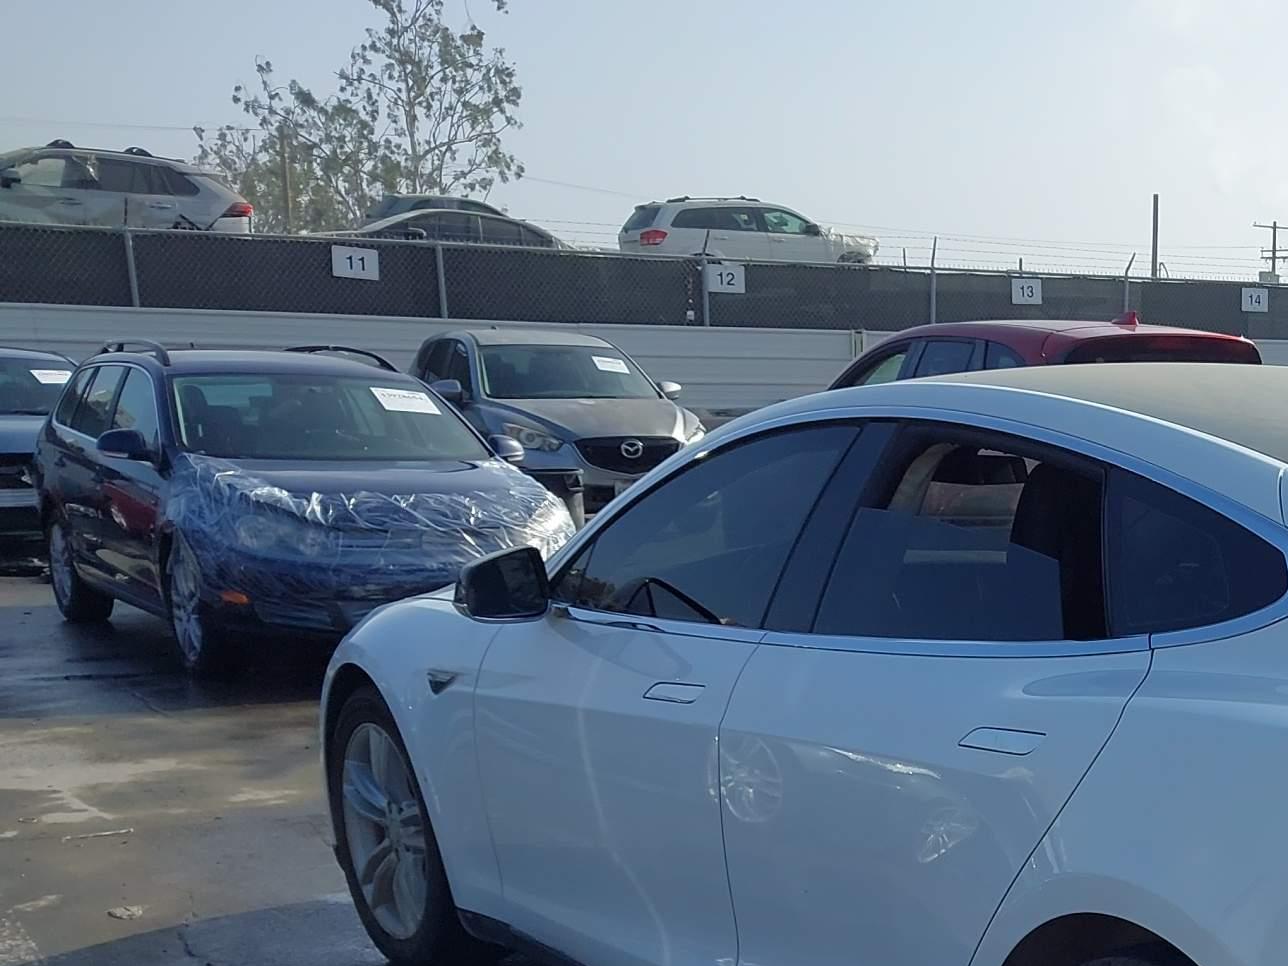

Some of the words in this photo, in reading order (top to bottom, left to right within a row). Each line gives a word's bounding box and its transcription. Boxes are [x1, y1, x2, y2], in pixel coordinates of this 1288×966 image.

[345, 255, 366, 272] 11
[716, 271, 736, 286] 12
[1019, 285, 1034, 298] 13
[1248, 294, 1261, 306] 14
